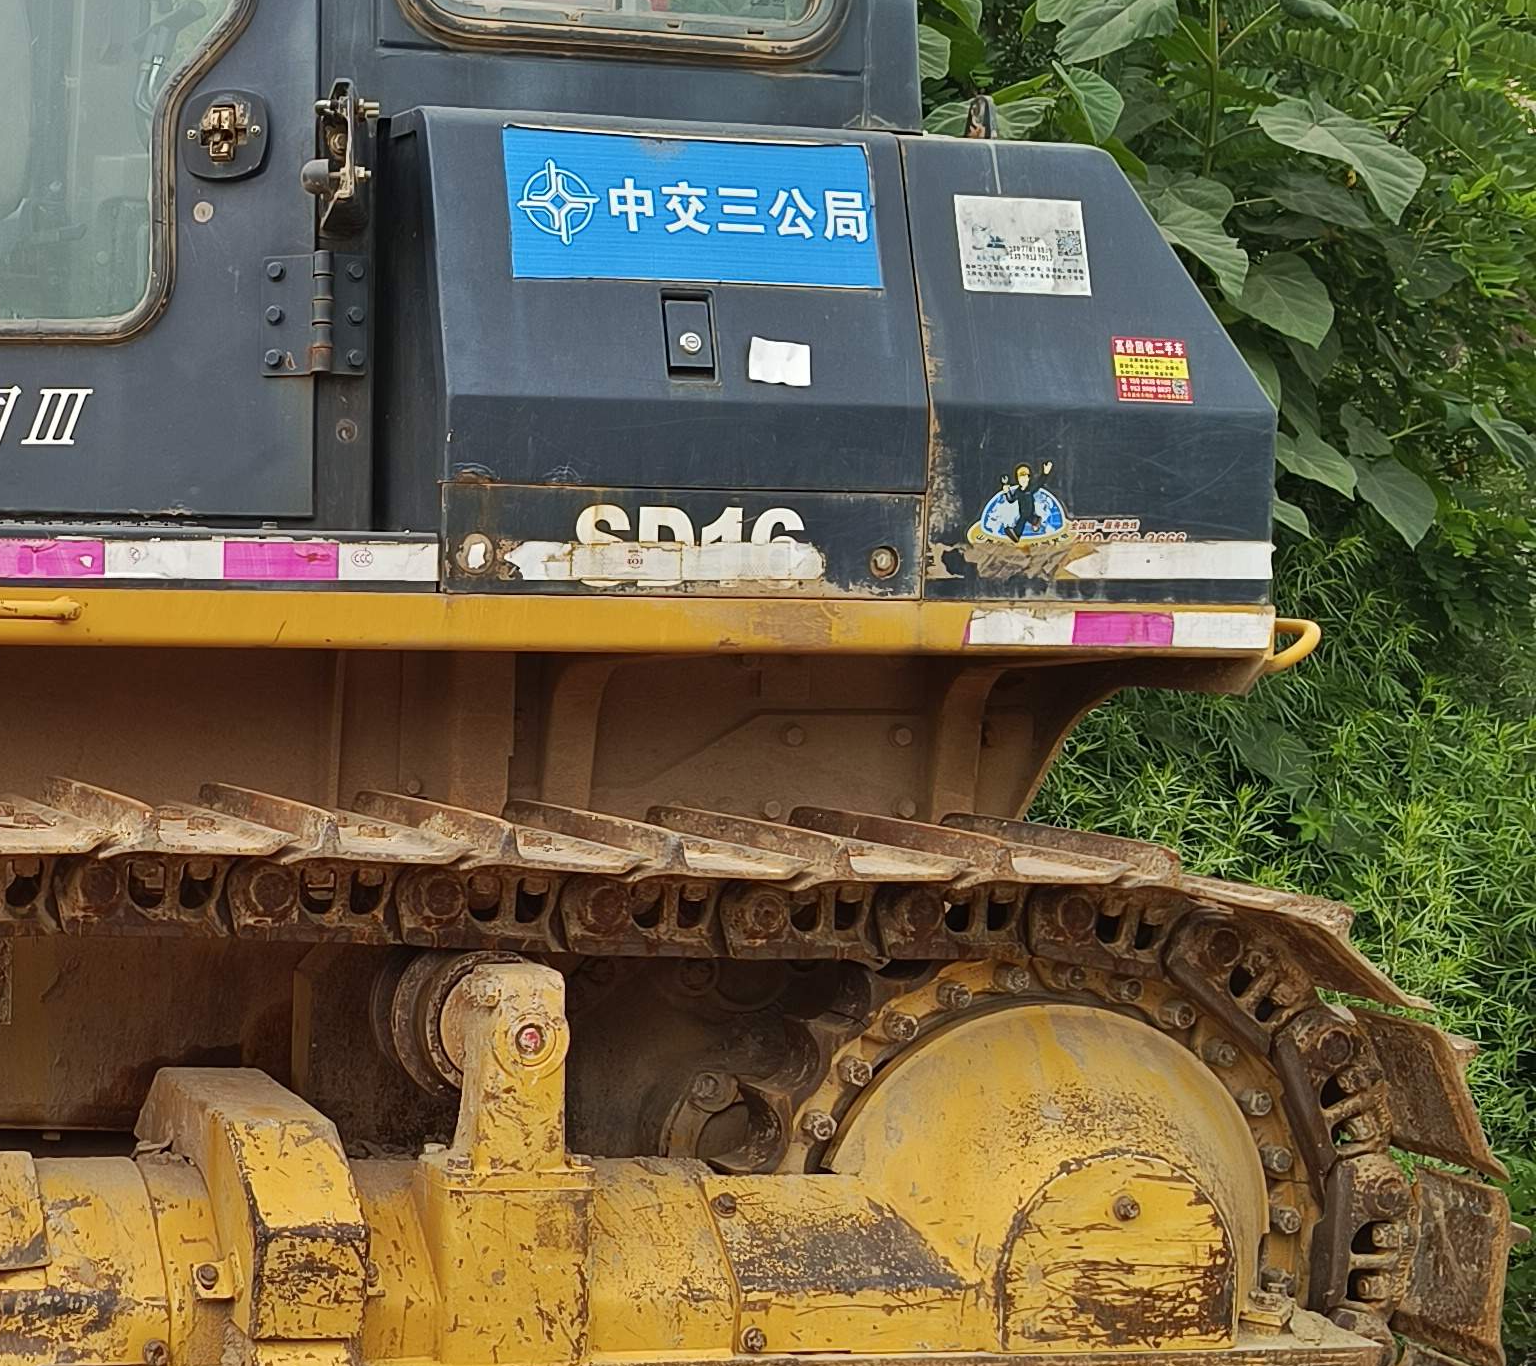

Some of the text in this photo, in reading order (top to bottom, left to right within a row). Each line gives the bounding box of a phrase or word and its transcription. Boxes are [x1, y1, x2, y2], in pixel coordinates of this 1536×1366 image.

[607, 177, 869, 243] 中交三公局
